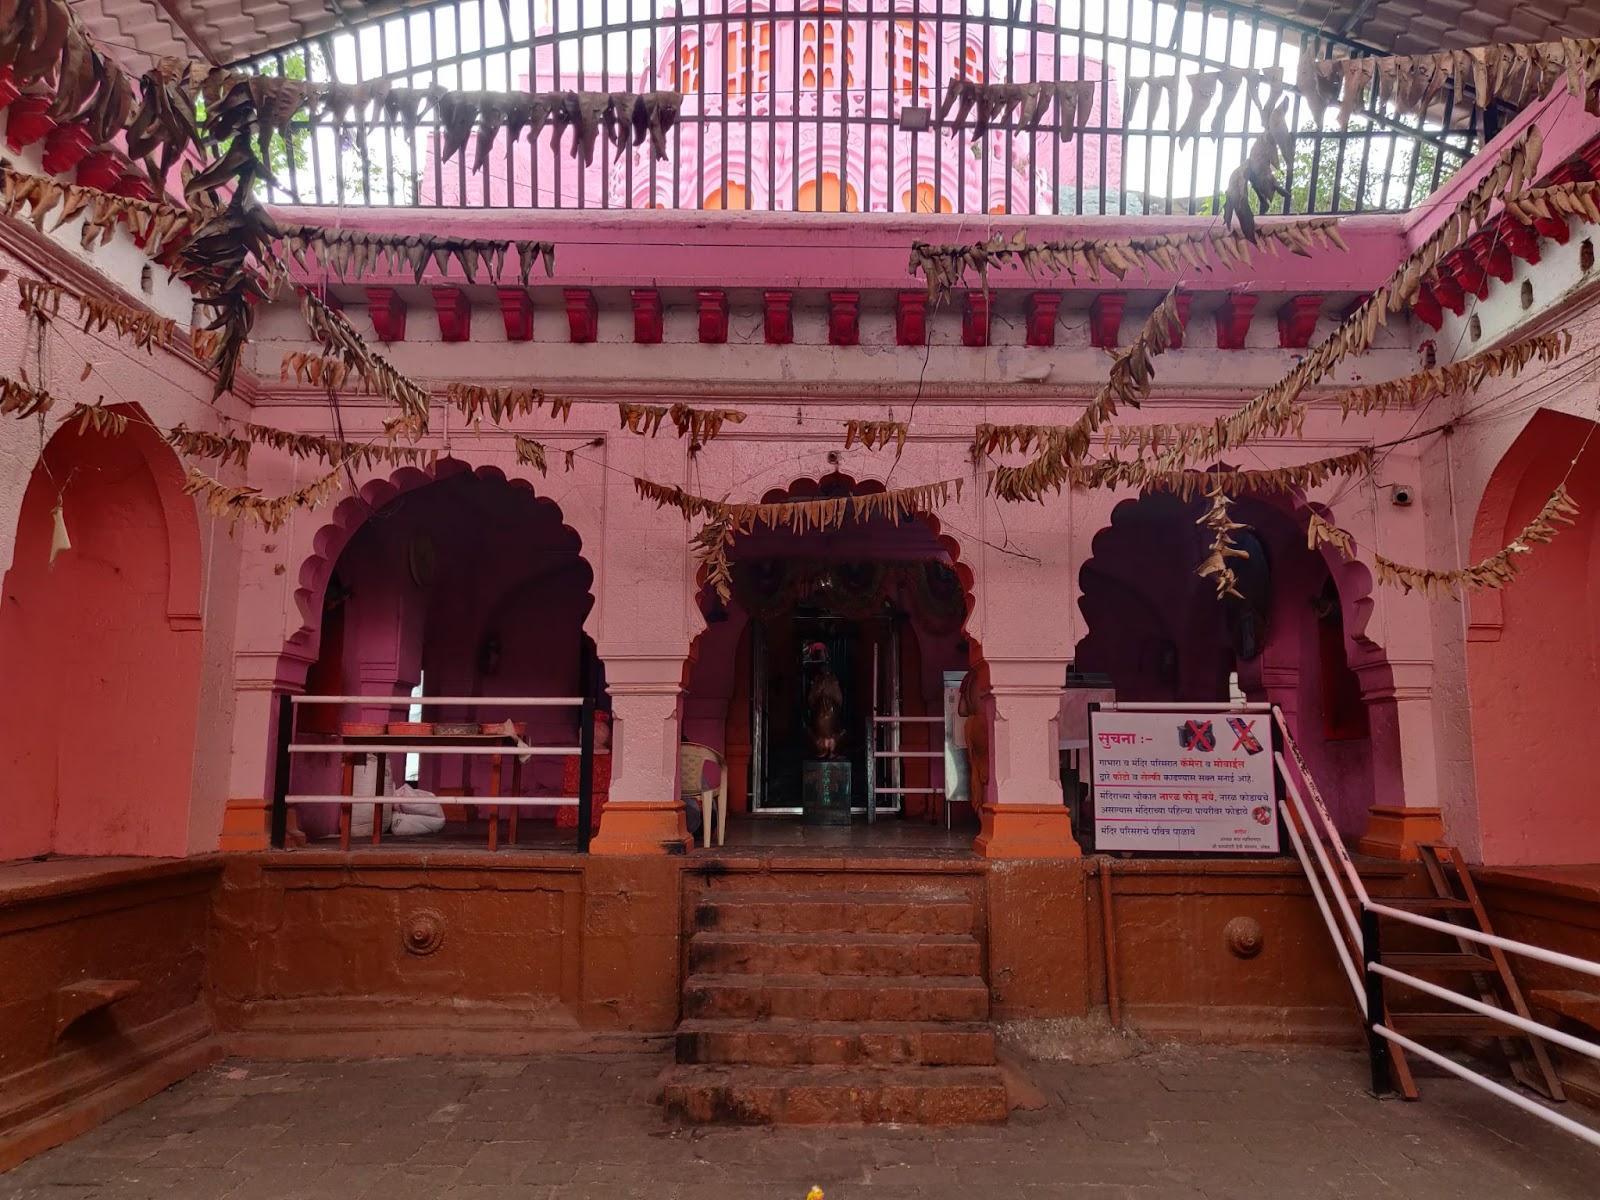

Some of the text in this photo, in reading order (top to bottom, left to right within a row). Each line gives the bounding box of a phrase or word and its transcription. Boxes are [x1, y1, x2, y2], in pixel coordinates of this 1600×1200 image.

[1123, 759, 1130, 767] व
[1132, 757, 1147, 767] मंदिर
[1150, 758, 1177, 767] परिसरात
[1112, 771, 1130, 781] फोटो
[1132, 773, 1138, 781] व
[1217, 772, 1234, 782] मनाई
[1099, 789, 1131, 800] मंदिराच्या
[1182, 790, 1199, 803] फोडू
[1219, 793, 1237, 801] नारळ
[1135, 804, 1165, 815] मंदिराच्या
[1167, 804, 1192, 815] पहिल्या
[1195, 805, 1222, 815] पायरीवर
[1225, 805, 1248, 815] फोडावे
[1101, 825, 1117, 834] मंदिर
[1172, 826, 1195, 835] पाळावे
